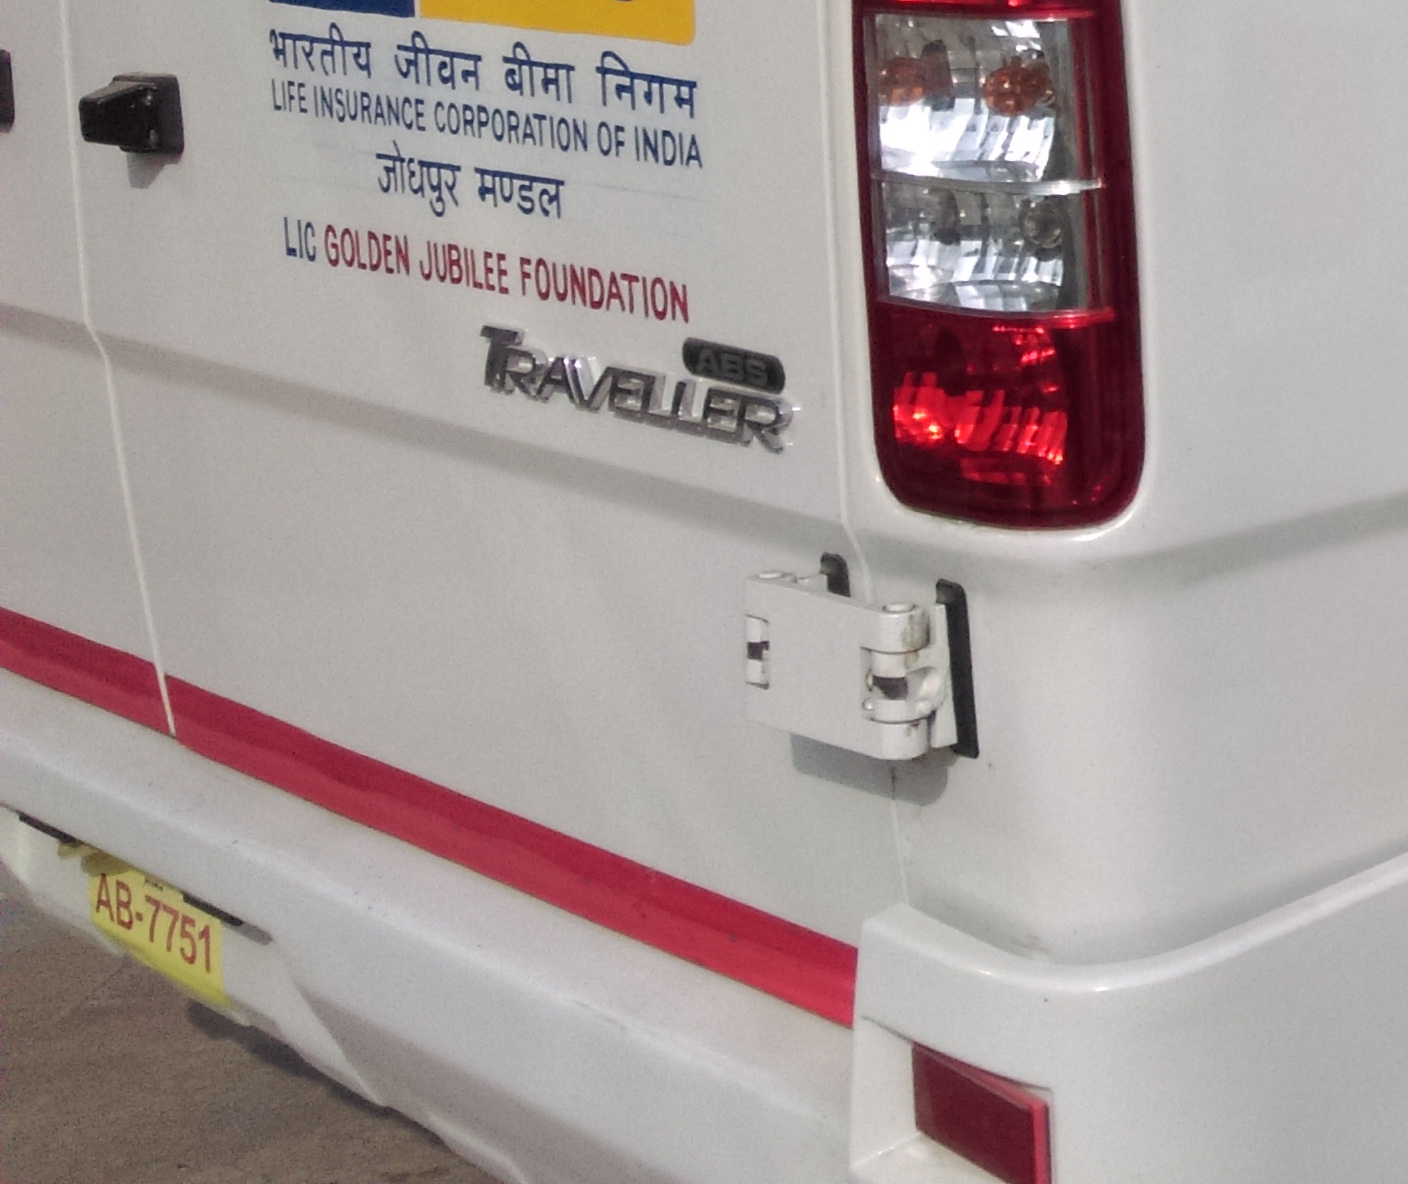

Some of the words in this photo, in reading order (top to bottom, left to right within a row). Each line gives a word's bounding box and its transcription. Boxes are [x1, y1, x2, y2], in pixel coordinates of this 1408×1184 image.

[269, 22, 371, 79] भारतीय
[394, 30, 482, 92] जीवन
[502, 41, 575, 104] बीमा
[596, 50, 698, 119] निगम
[271, 78, 308, 114] LIFE
[313, 85, 426, 133] INSURANCE
[434, 99, 588, 153] CORPORATION
[597, 120, 626, 159] OF
[634, 126, 704, 169] INDIA
[376, 140, 461, 217] जोधपुर
[474, 165, 564, 218] मण्डल
[283, 216, 317, 263] LIC
[323, 223, 411, 277] GOLDEN
[418, 239, 509, 296] JUBILEE
[519, 256, 690, 324] FOUNDATION
[479, 323, 801, 454] TRAVELLER
[696, 347, 769, 388] ABS
[96, 873, 212, 972] AB-7751
